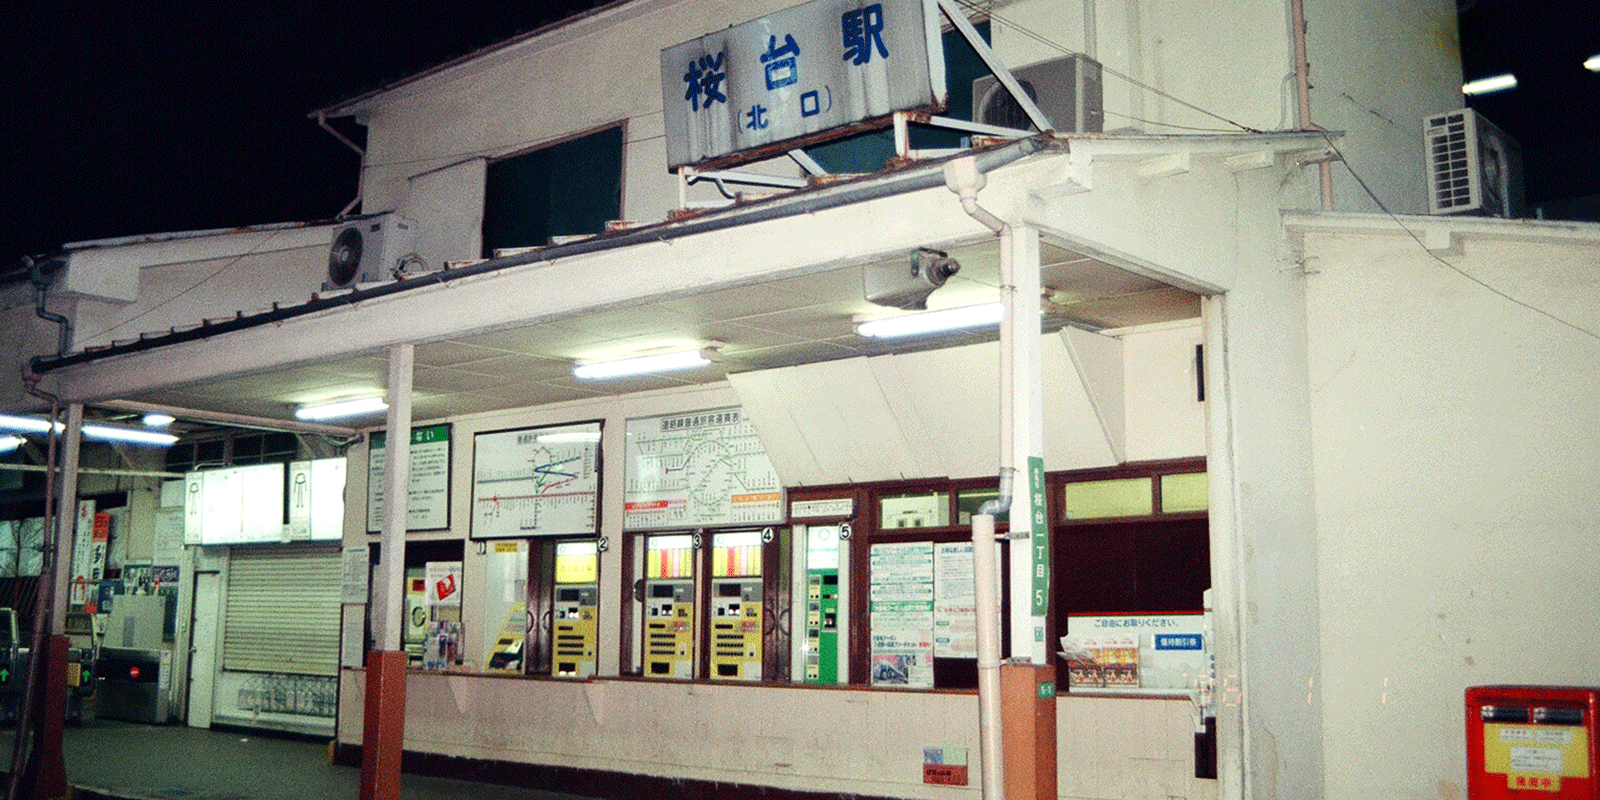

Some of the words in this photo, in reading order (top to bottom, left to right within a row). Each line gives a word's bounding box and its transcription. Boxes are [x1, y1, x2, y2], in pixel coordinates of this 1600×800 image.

[684, 3, 889, 111] 桜台駅
[763, 528, 772, 540] 4
[842, 526, 850, 538] 5
[600, 538, 607, 549] 2
[694, 534, 700, 547] 3
[1036, 589, 1043, 606] 5
